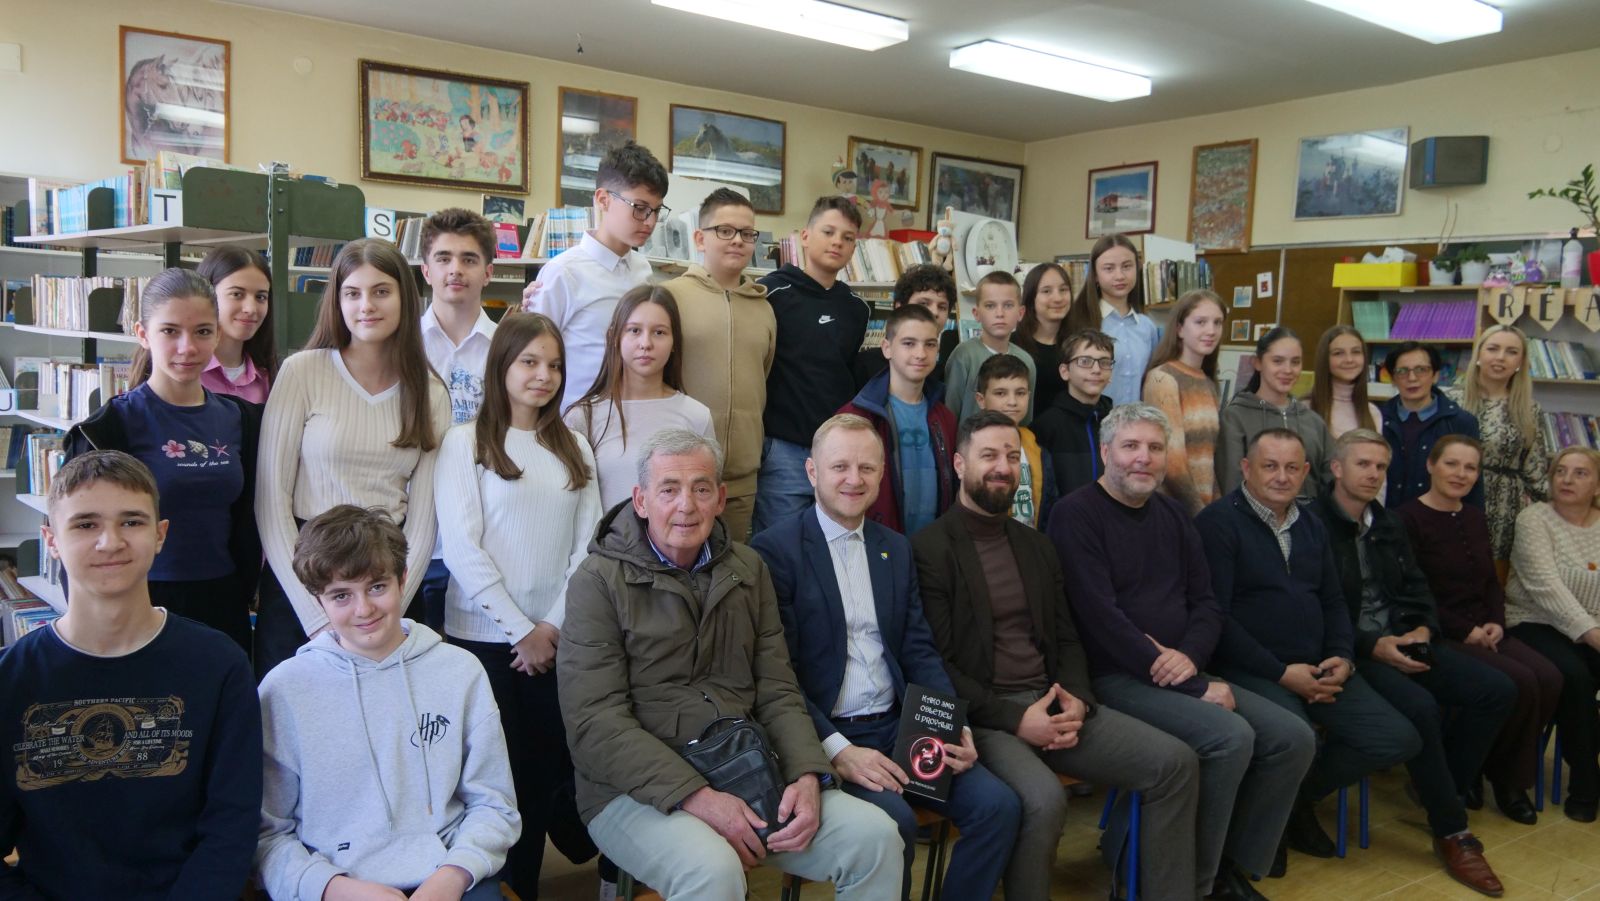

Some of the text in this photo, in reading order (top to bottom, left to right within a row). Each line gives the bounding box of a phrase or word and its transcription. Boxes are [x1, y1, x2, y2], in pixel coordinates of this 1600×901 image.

[154, 194, 177, 222] T
[374, 214, 391, 236] S
[73, 697, 136, 706] SOUTHERN PACIFIC
[124, 729, 193, 740] AND ALL OF ITS MOODS
[13, 739, 47, 751] CELEBRATE
[48, 736, 60, 747] THE
[60, 734, 85, 745] WATER
[136, 752, 149, 762] 88
[53, 758, 63, 768] 19
